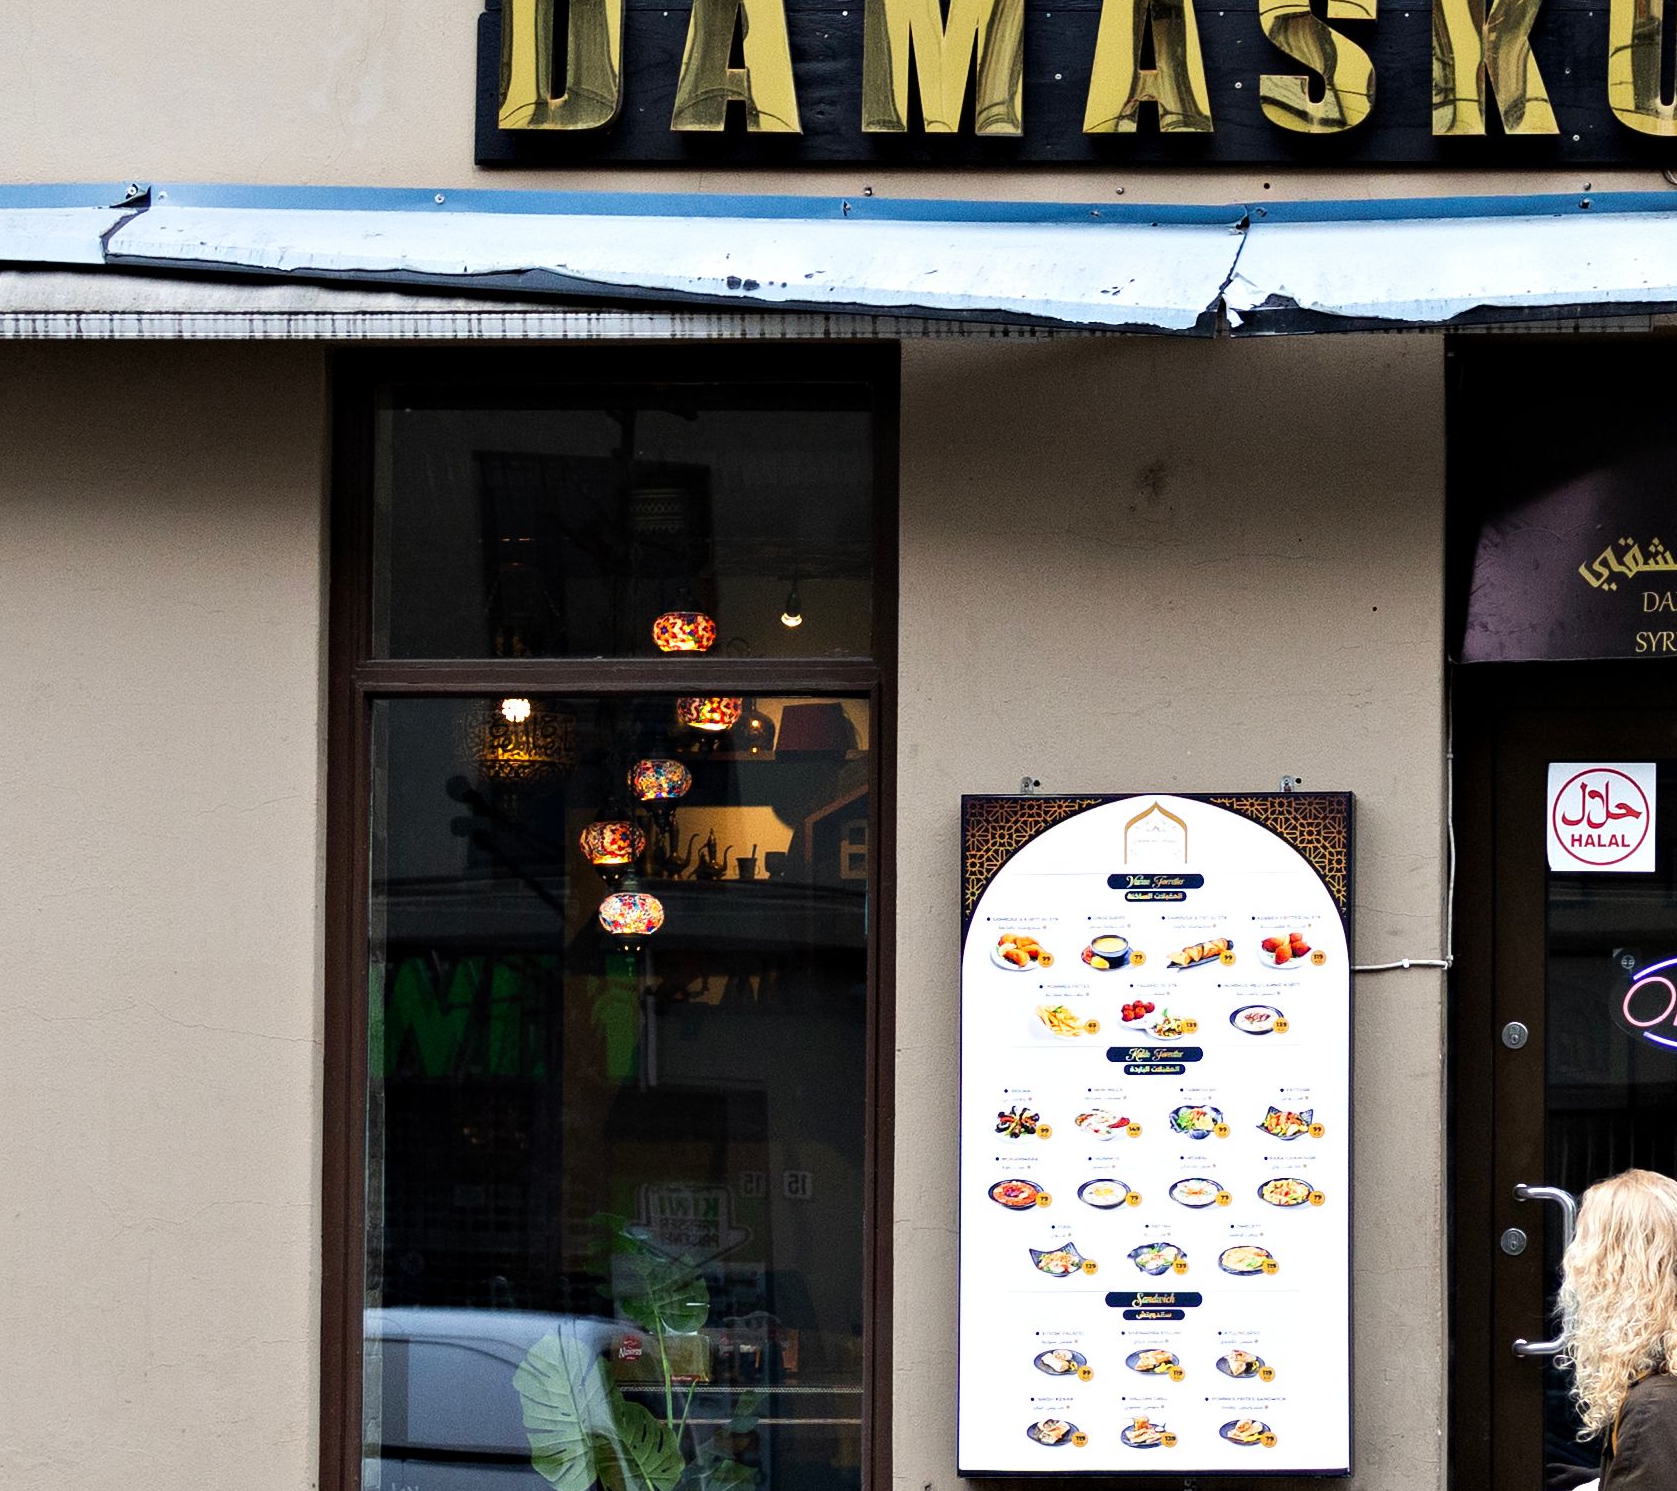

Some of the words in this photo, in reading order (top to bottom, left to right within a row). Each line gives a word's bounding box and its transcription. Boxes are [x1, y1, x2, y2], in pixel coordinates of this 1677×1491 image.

[1562, 780, 1643, 829] حلال
[1571, 834, 1631, 847] HALAL
[1131, 1292, 1175, 1307] Sandwich
